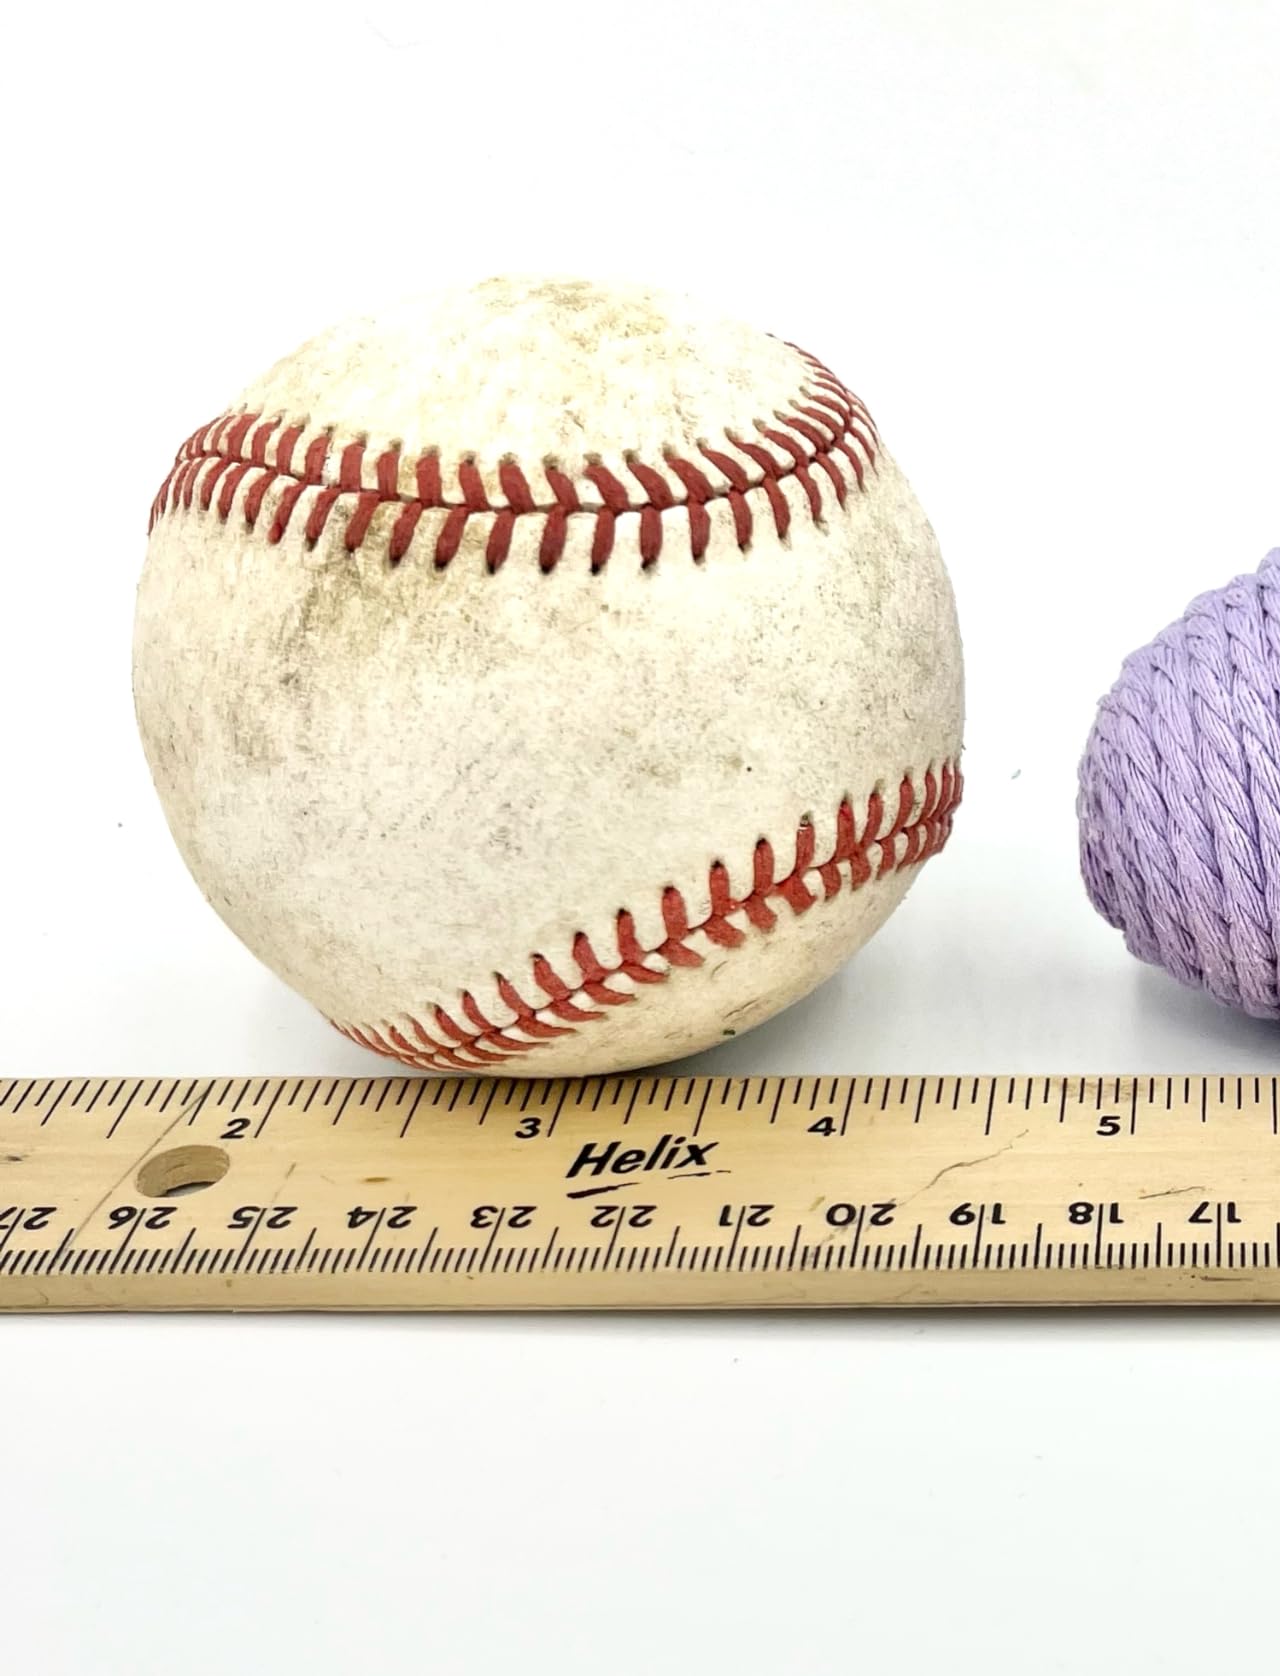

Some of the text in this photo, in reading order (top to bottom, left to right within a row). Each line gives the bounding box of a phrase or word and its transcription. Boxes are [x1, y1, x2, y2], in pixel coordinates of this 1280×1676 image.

[220, 1118, 251, 1140] 2
[514, 1116, 542, 1139] 3
[807, 1116, 837, 1137] 4
[1096, 1115, 1121, 1137] 5
[565, 1134, 719, 1179] Helix
[108, 1206, 178, 1230] 26
[227, 1206, 298, 1229] 25
[347, 1206, 418, 1229] 24
[470, 1205, 537, 1229] 23
[590, 1205, 657, 1228] 22
[718, 1204, 775, 1227] 21
[825, 1203, 897, 1227] 20
[949, 1202, 1006, 1226] 19
[1068, 1201, 1124, 1225] 18
[1188, 1201, 1242, 1224] 17
